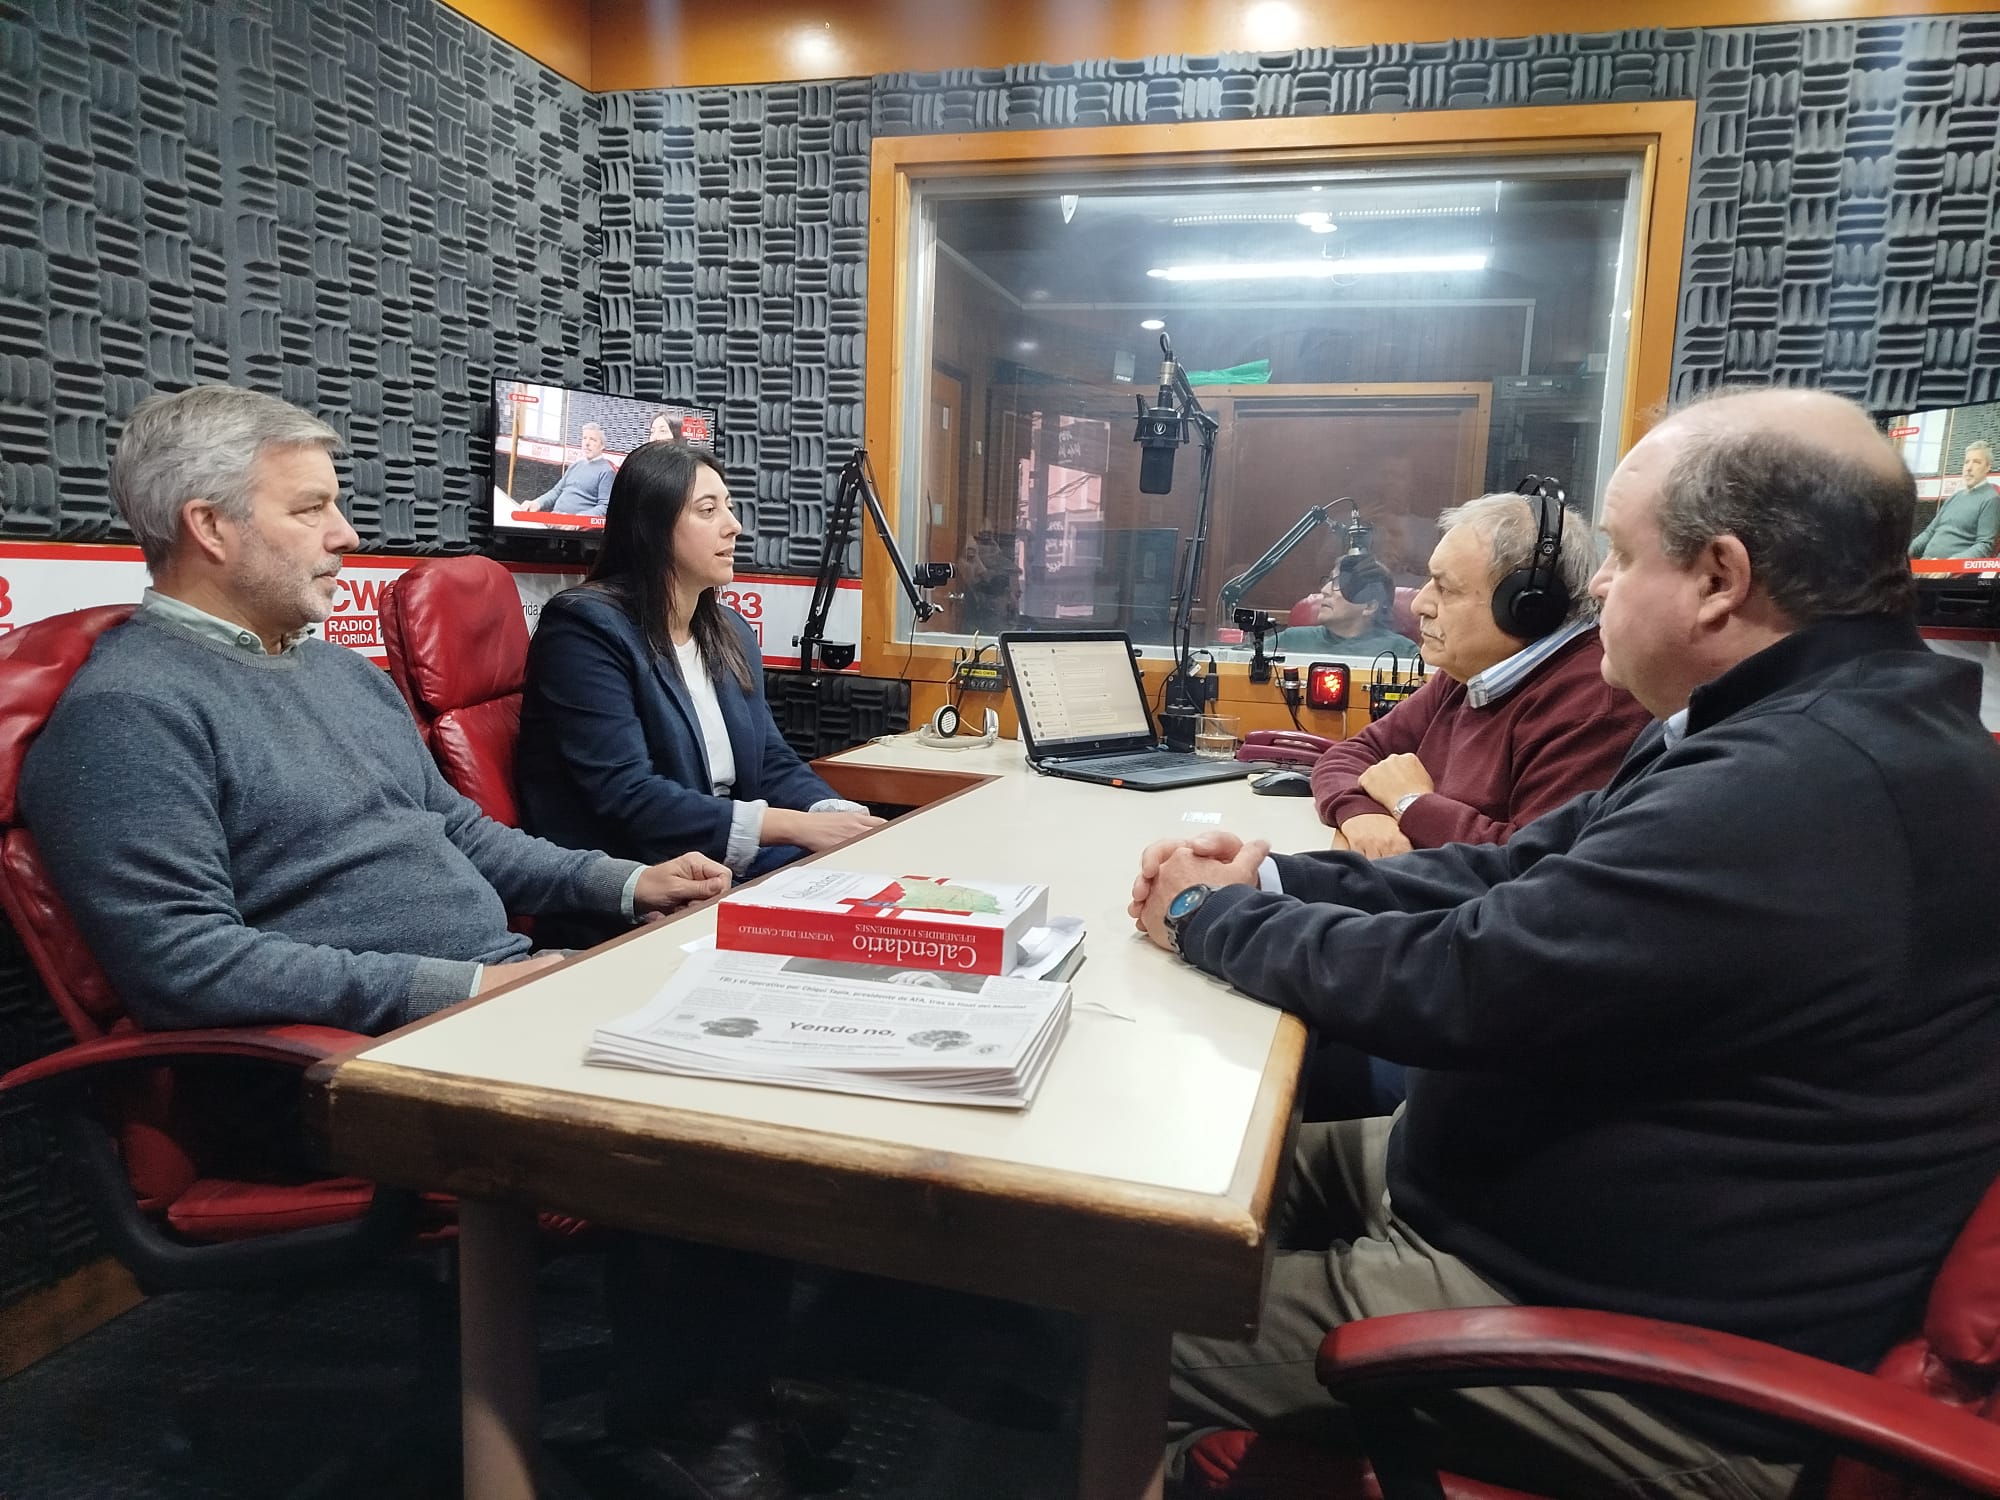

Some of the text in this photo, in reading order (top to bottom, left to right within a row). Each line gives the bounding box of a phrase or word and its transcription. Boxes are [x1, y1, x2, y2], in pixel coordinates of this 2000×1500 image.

[333, 579, 392, 612] CW
[715, 590, 763, 619] 33
[328, 619, 373, 633] RADIO
[329, 633, 375, 645] FLORIDA
[738, 925, 834, 942] VICENTE DEL CASTILLO
[855, 924, 916, 937] FLORIDENSES
[852, 935, 977, 969] Calendario
[791, 1021, 896, 1037] Yendo no,
